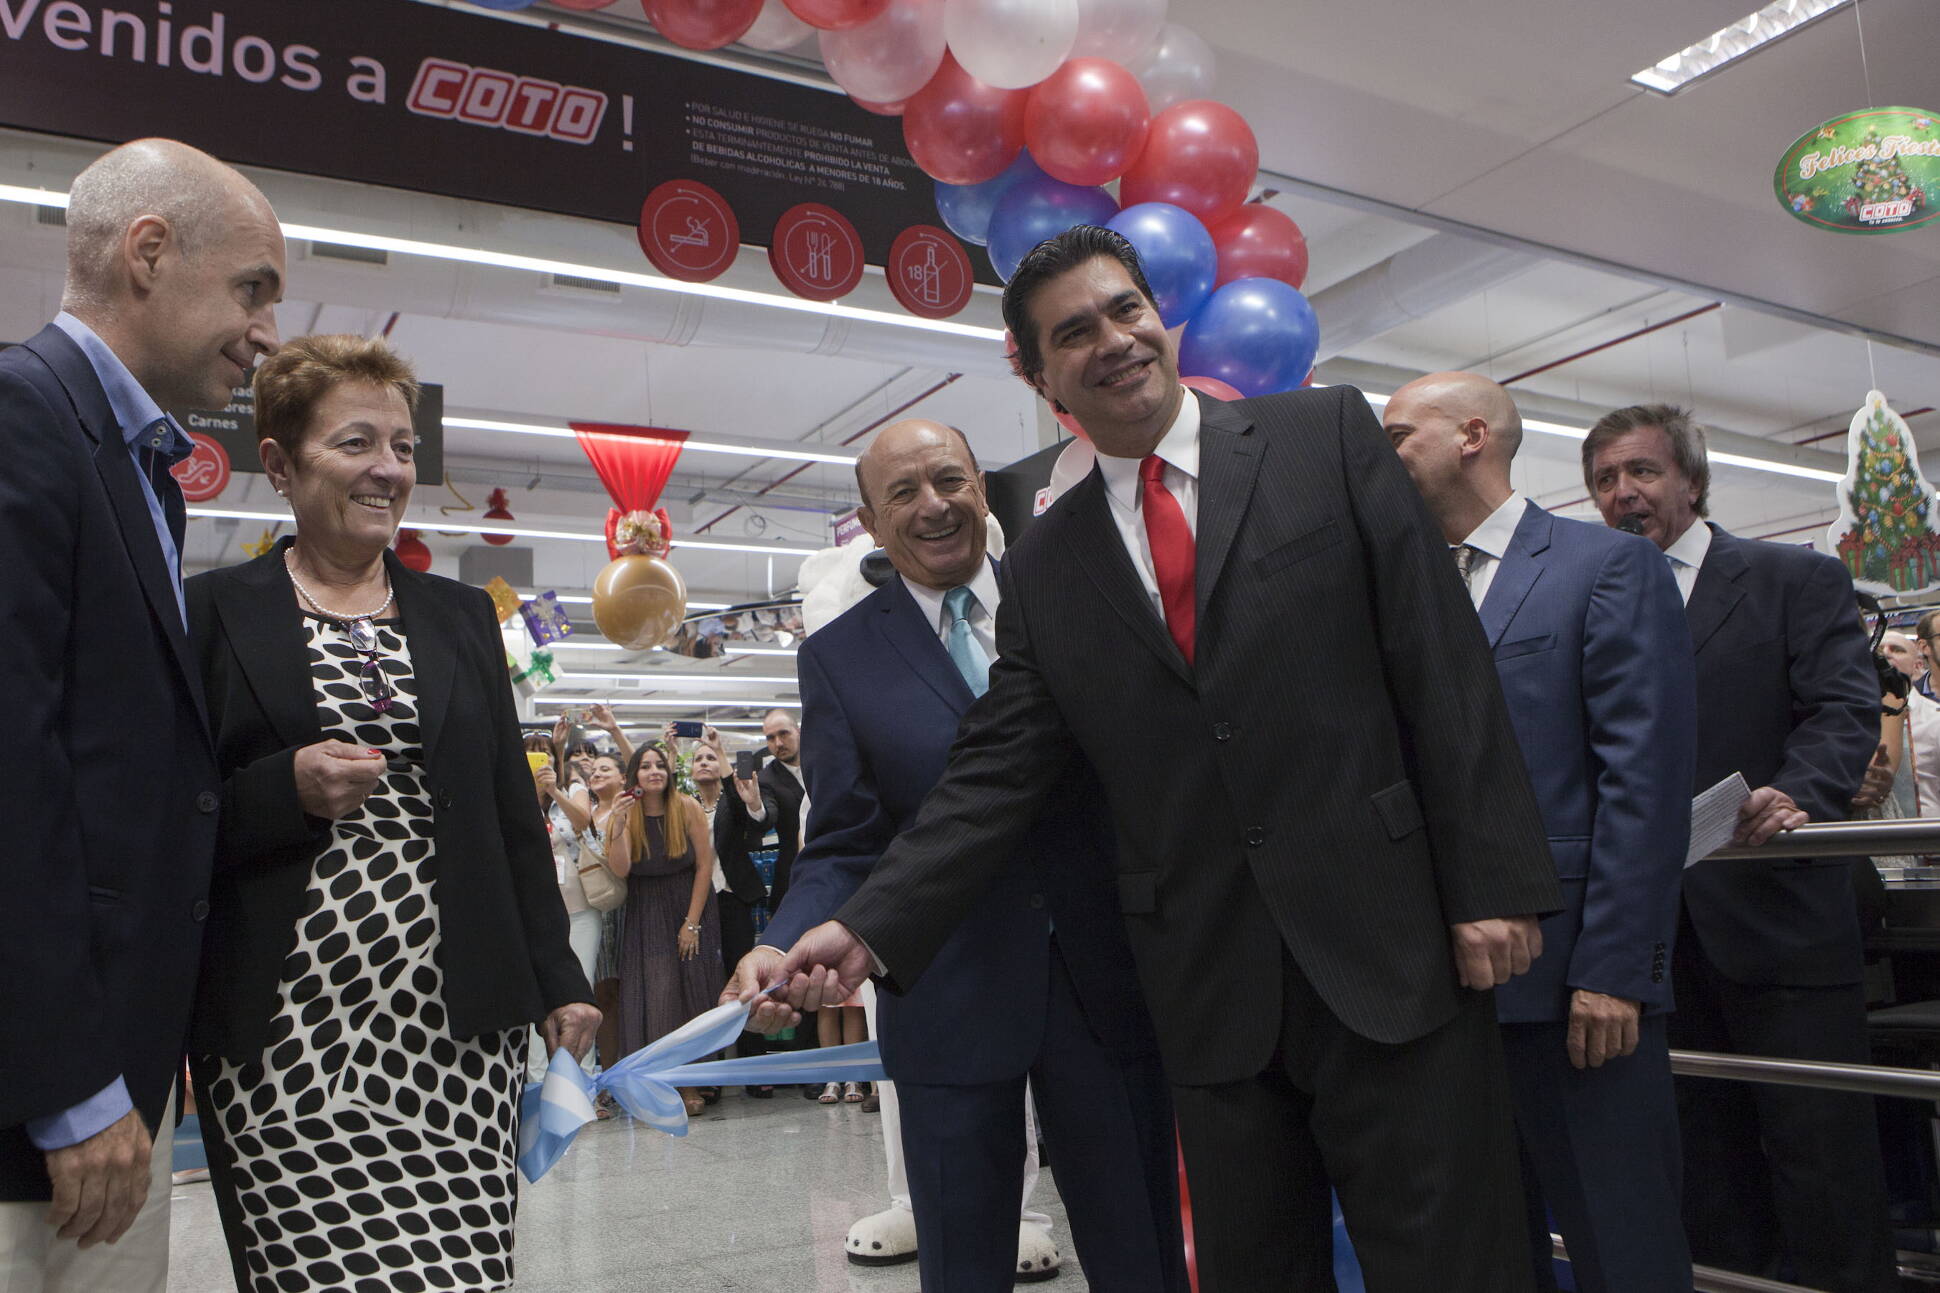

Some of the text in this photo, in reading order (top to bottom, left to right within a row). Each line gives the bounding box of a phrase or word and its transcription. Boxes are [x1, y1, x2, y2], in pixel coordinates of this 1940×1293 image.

[0, 0, 322, 91] venidos
[346, 56, 387, 104] a
[409, 59, 605, 142] COTO
[691, 102, 711, 113] POR
[711, 103, 743, 120] SALUD
[830, 131, 843, 141] NO
[843, 133, 873, 147] FUMAR
[692, 115, 706, 125] NO
[707, 118, 754, 136] CONSUMIR
[755, 127, 807, 147] PRODUCTOS
[808, 139, 820, 149] DE
[822, 141, 849, 154] VENTA
[849, 147, 878, 161] ANTES
[692, 140, 705, 152] DE
[706, 143, 745, 160] BEBIDAS
[746, 151, 806, 171] ALCOHOLICAS
[808, 164, 816, 173] A
[816, 165, 858, 182] MENORES
[858, 174, 871, 184] DE
[872, 176, 882, 186] 18
[804, 150, 850, 167] PROHIBIDO
[850, 160, 863, 171] LA
[863, 162, 890, 176] VENTA
[1800, 145, 1879, 180] Felices
[1860, 201, 1911, 220] COTO
[907, 265, 923, 281] 18
[188, 413, 239, 430] Carnes
